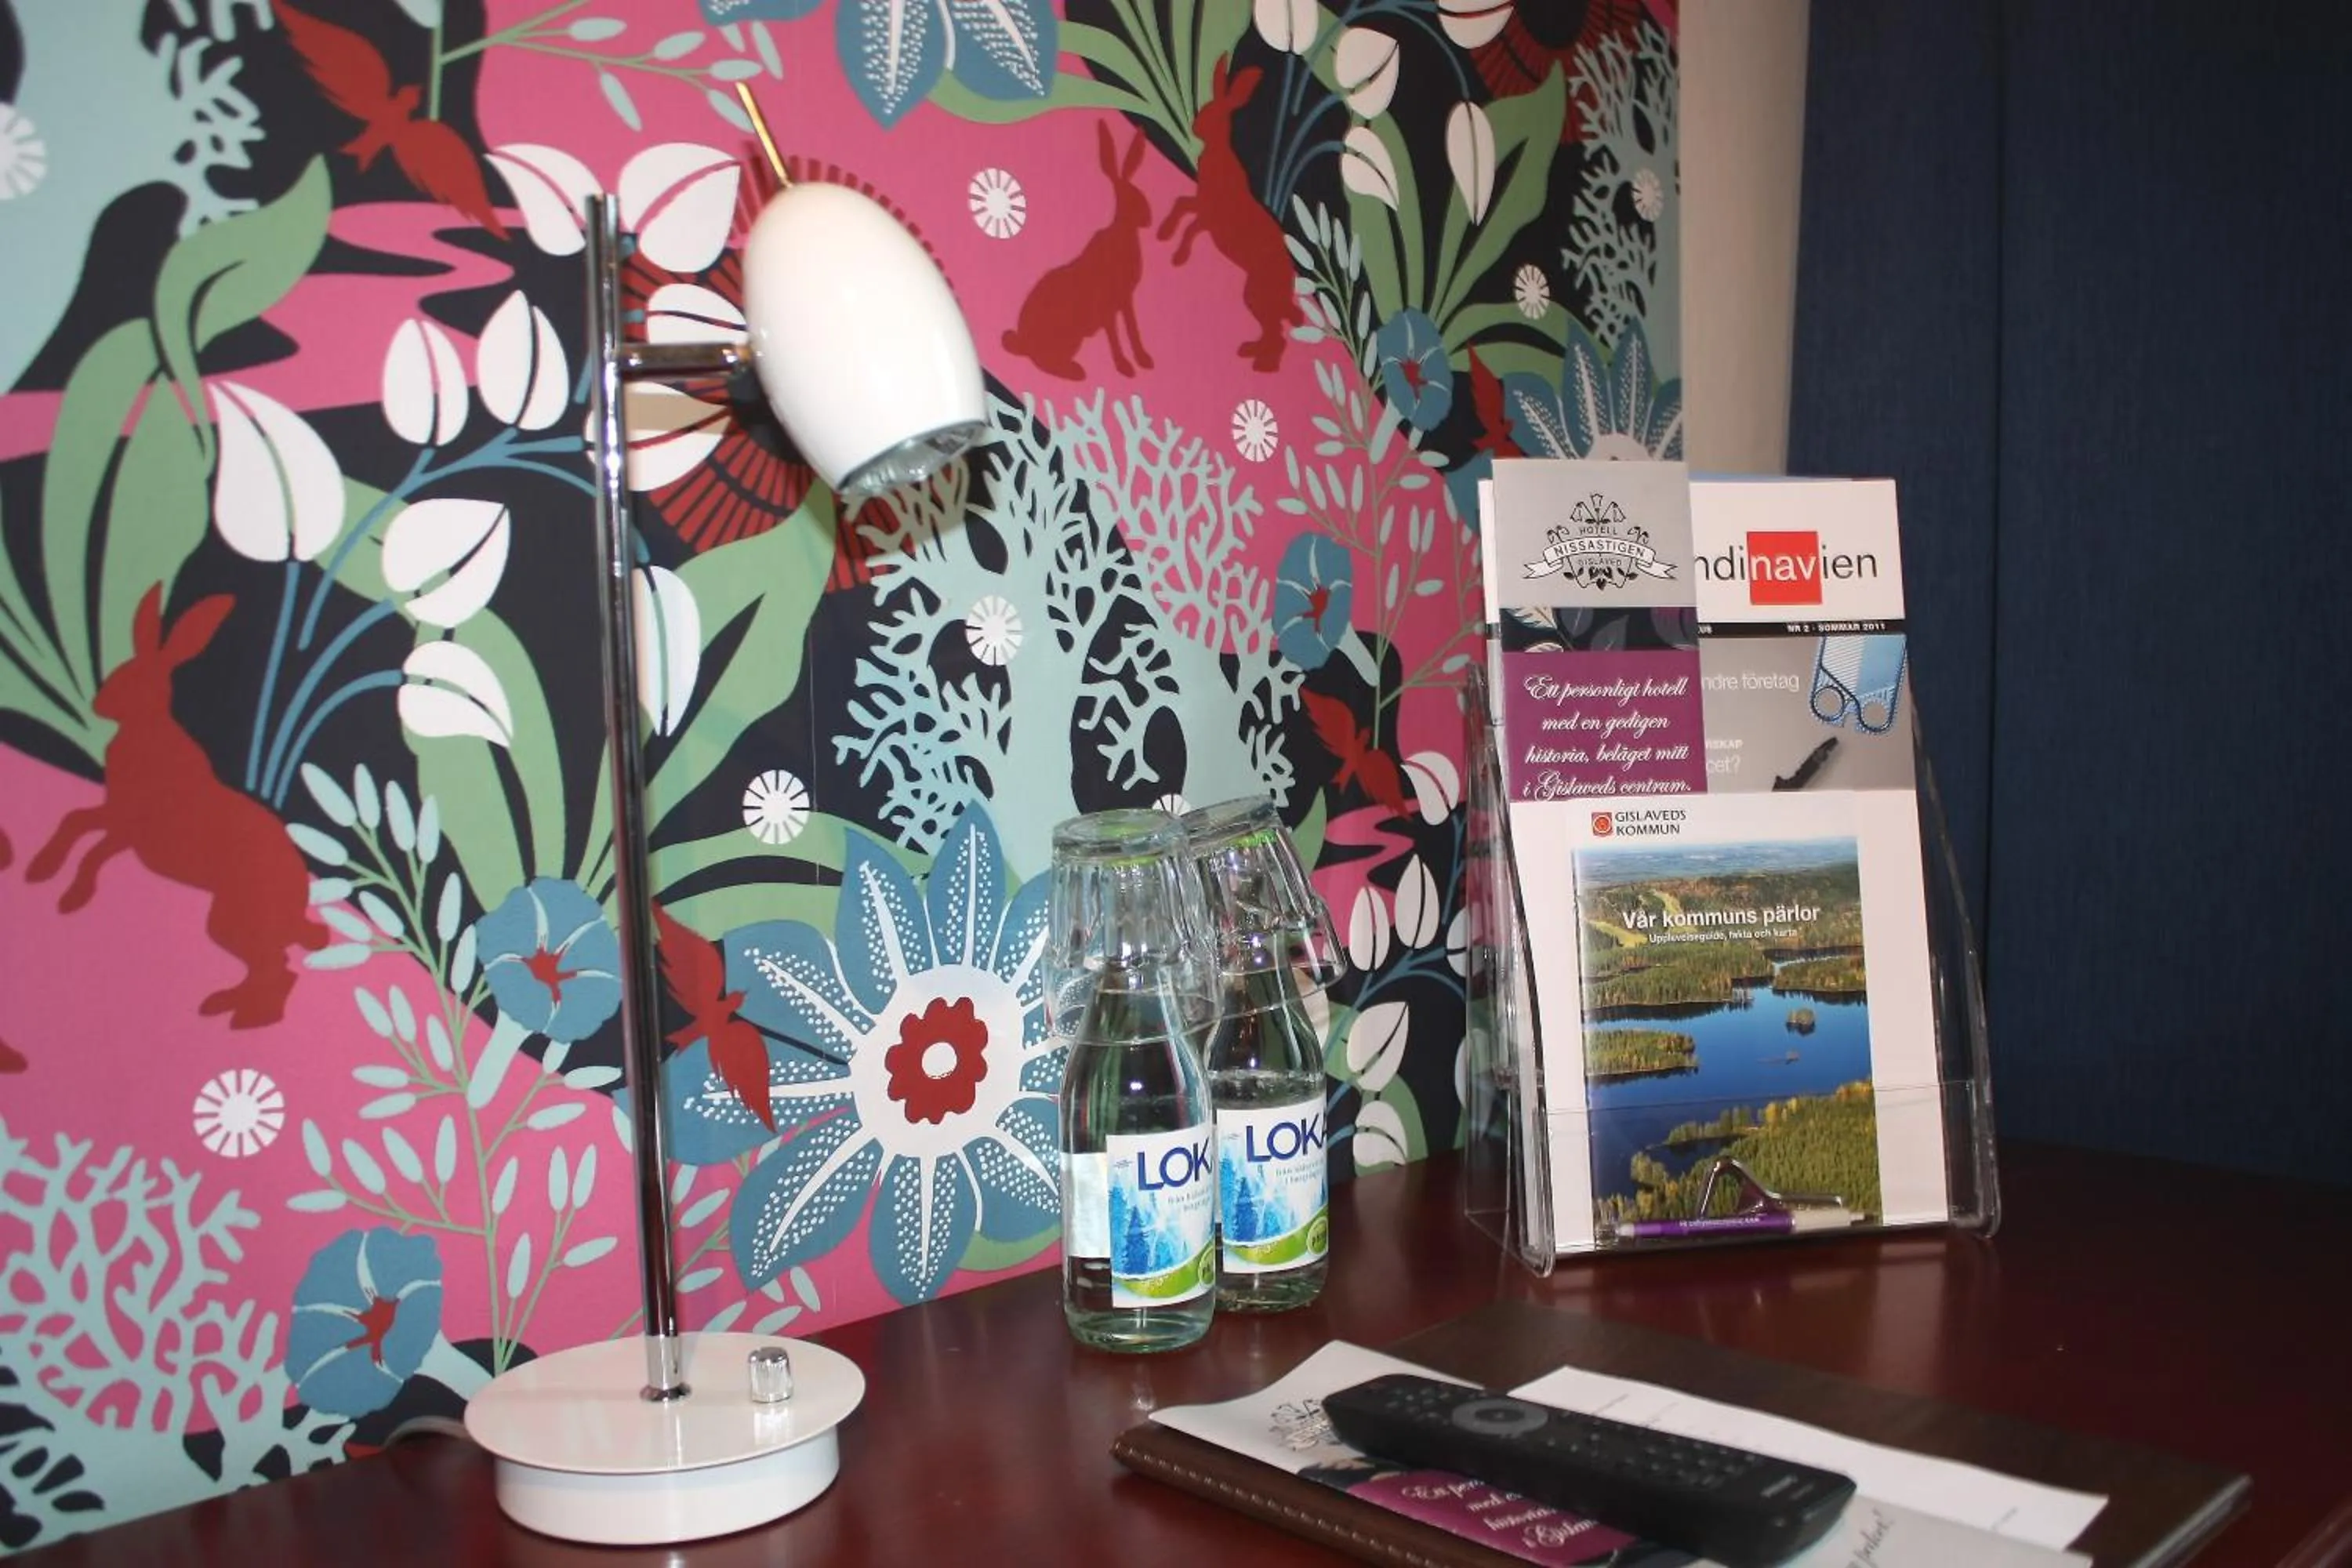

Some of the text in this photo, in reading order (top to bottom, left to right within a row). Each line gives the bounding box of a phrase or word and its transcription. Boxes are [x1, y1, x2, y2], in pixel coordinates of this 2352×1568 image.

[1580, 526, 1618, 535] HOTELL
[1553, 539, 1646, 558] NISSASTIGEN
[1818, 623, 1860, 632] SOMMAR
[1524, 674, 1689, 706] Ett personligt hotell
[1742, 673, 1800, 692] företag
[1542, 711, 1671, 739] med en gedigen
[1525, 744, 1690, 772] historia, beläget mitt
[1523, 768, 1691, 800] i Gislaveds centrum.
[1615, 810, 1686, 822] GISLAVEDS
[1616, 824, 1680, 836] KOMMUN
[1623, 904, 1820, 929] Vår kommuns pärlor
[1729, 931, 1751, 940] fakta
[1755, 929, 1771, 938] och
